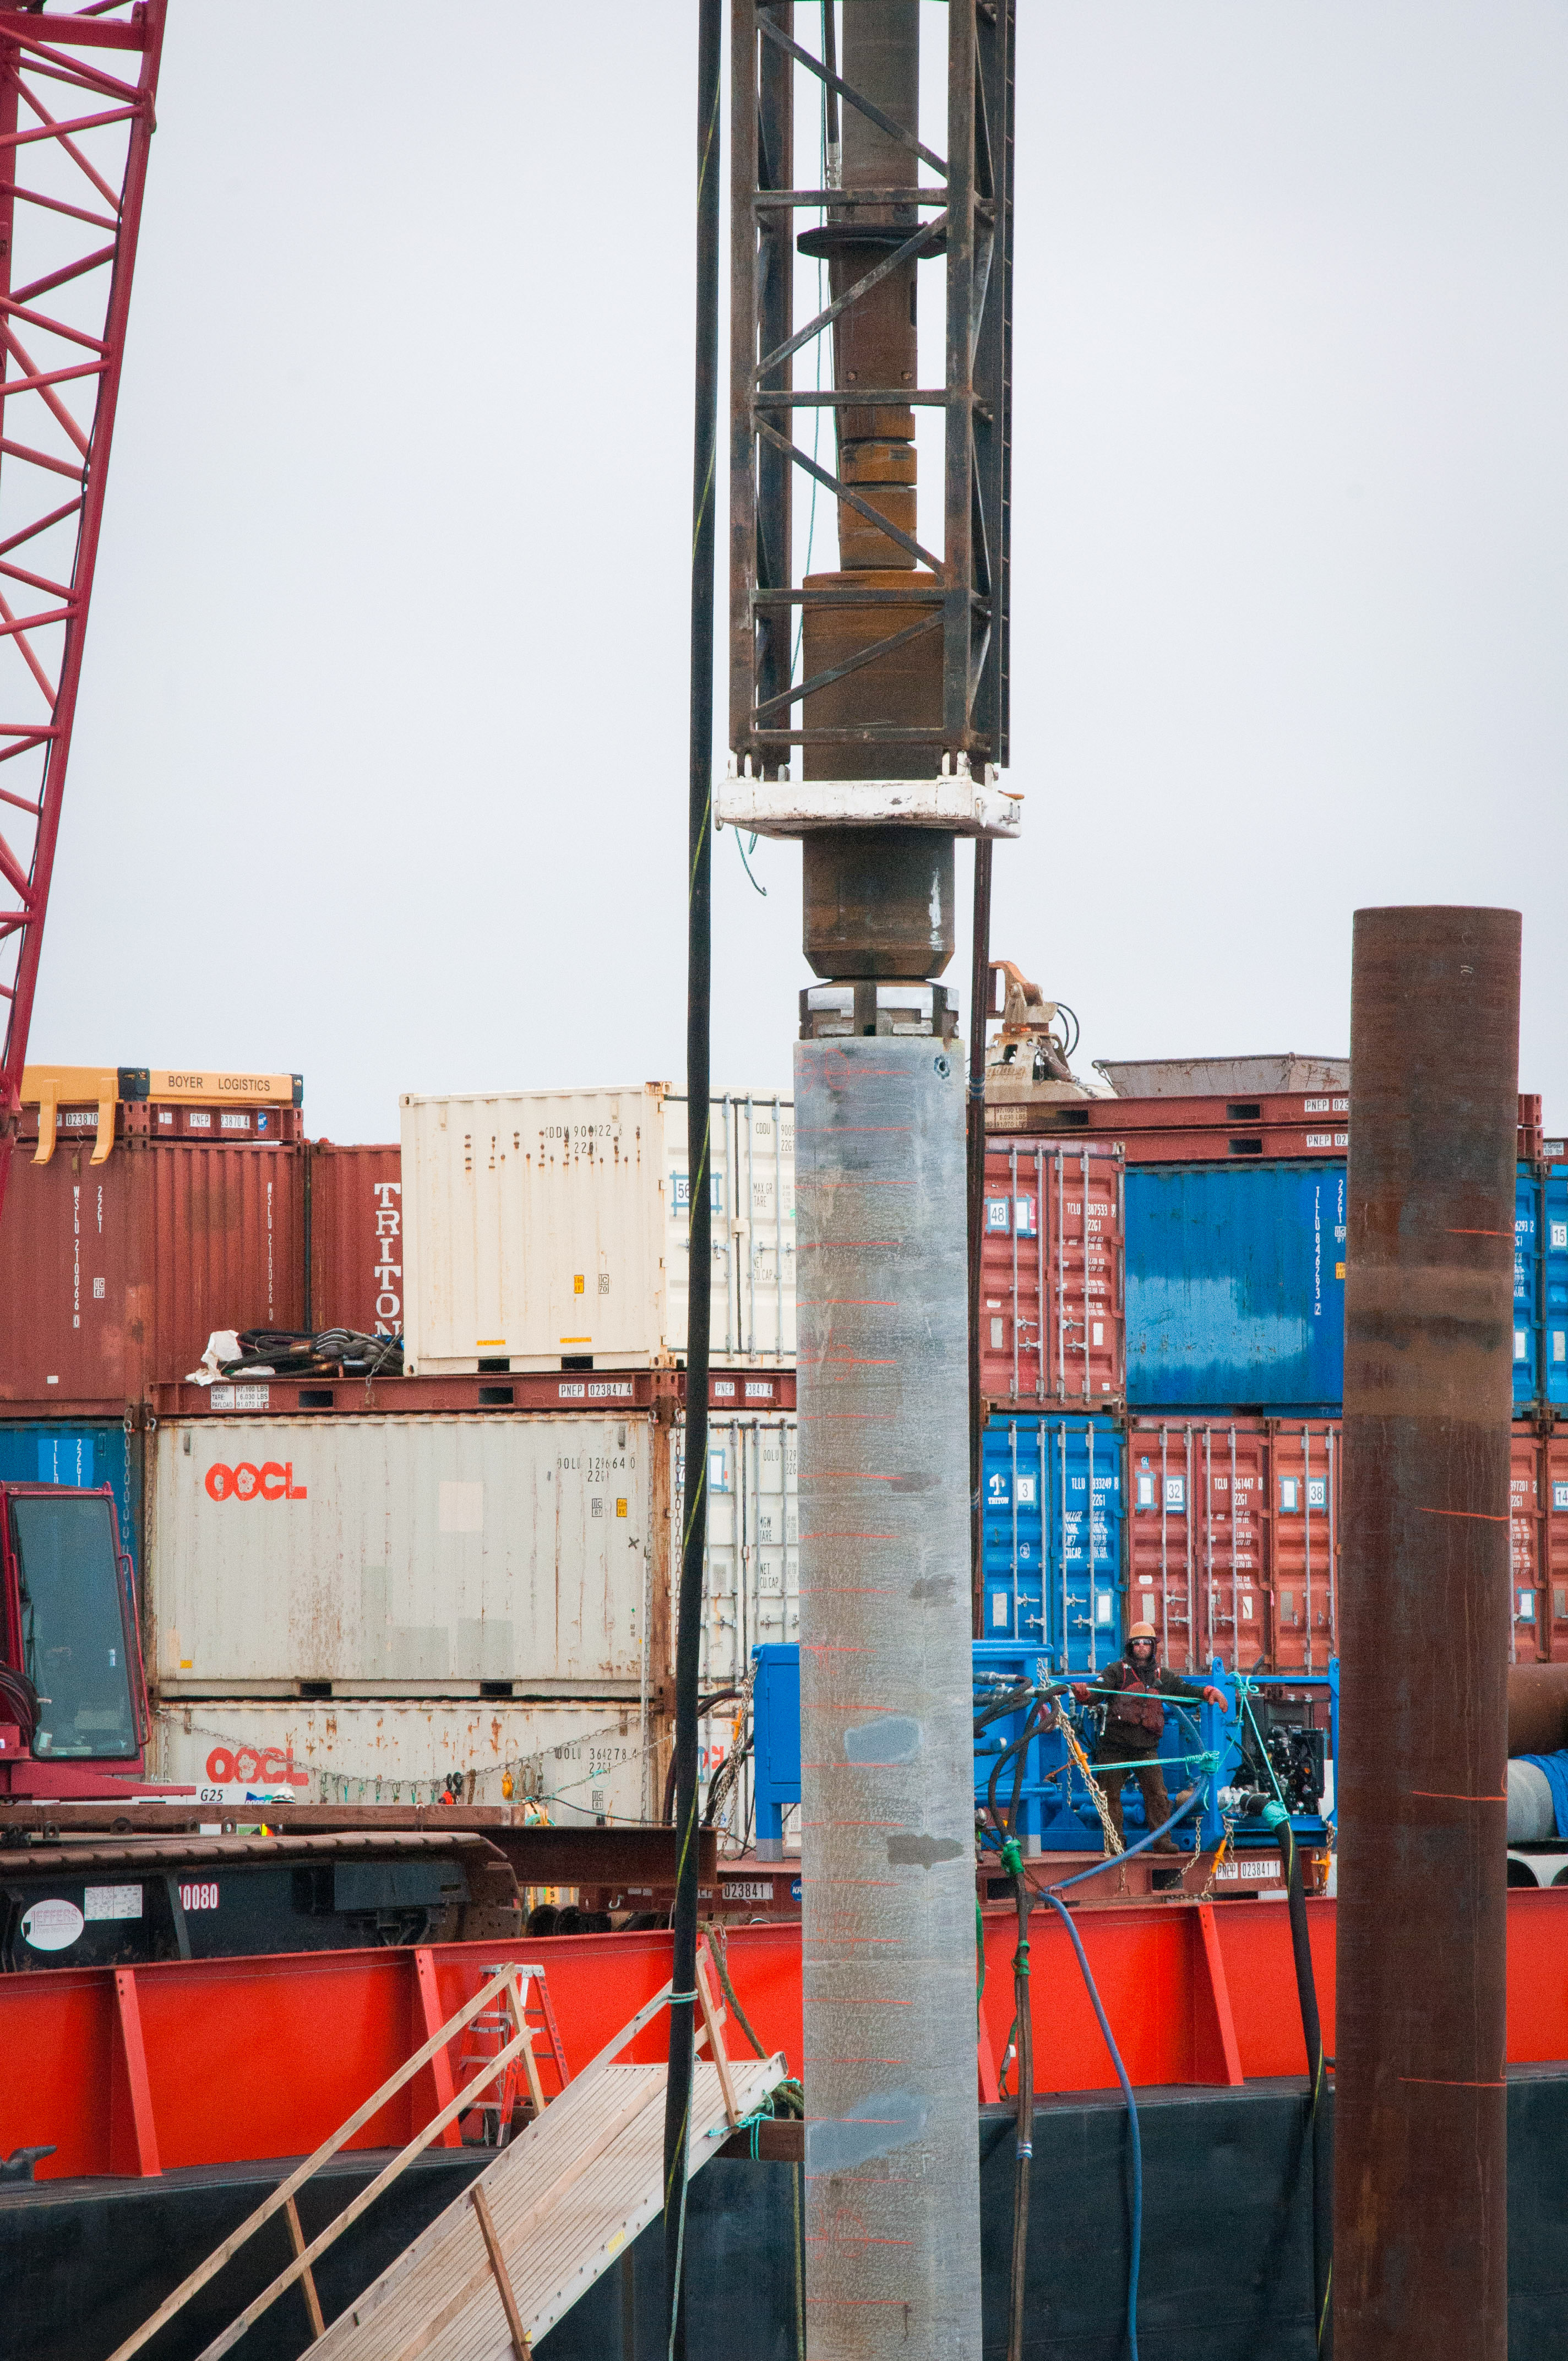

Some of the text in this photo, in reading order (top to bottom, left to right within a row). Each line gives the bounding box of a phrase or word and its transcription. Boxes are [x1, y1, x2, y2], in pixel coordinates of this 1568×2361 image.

[168, 1076, 270, 1091] BOYER LOGISTICS
[1306, 1100, 1327, 1111] PNEP
[67, 1113, 98, 1125] 023870
[192, 1114, 209, 1125] PNEP
[756, 1123, 770, 1135] CDDU
[1309, 1134, 1347, 1145] PNEP 02
[754, 1195, 767, 1207] TARE
[991, 1207, 1004, 1222] 48
[1066, 1203, 1081, 1215] TCLU
[1087, 1220, 1101, 1232] 22G1
[1555, 1229, 1565, 1243] 15
[374, 1183, 402, 1336] TRITON
[74, 1314, 79, 1328] 0
[561, 1383, 631, 1397] PNEP 023847 4
[716, 1383, 733, 1395] PNEP
[764, 1449, 779, 1461] OOLU
[630, 1457, 635, 1469] 0
[204, 1461, 307, 1502] OOCL
[1071, 1477, 1086, 1490] TLLU
[1214, 1478, 1228, 1490] TCLU
[1235, 1478, 1254, 1490] 361447
[1022, 1482, 1028, 1498] 3
[1168, 1484, 1180, 1498] 32
[1311, 1486, 1322, 1500] 38
[1557, 1489, 1568, 1503] 14
[988, 1497, 1009, 1505] TRITON
[1092, 1494, 1106, 1506] 22G1
[1235, 1493, 1247, 1505] 22G1
[590, 1748, 627, 1760] 364278
[205, 1747, 309, 1786] OOCL
[200, 1789, 224, 1802] G25
[1242, 1862, 1270, 1876] 023841
[725, 1883, 764, 1898] 023841
